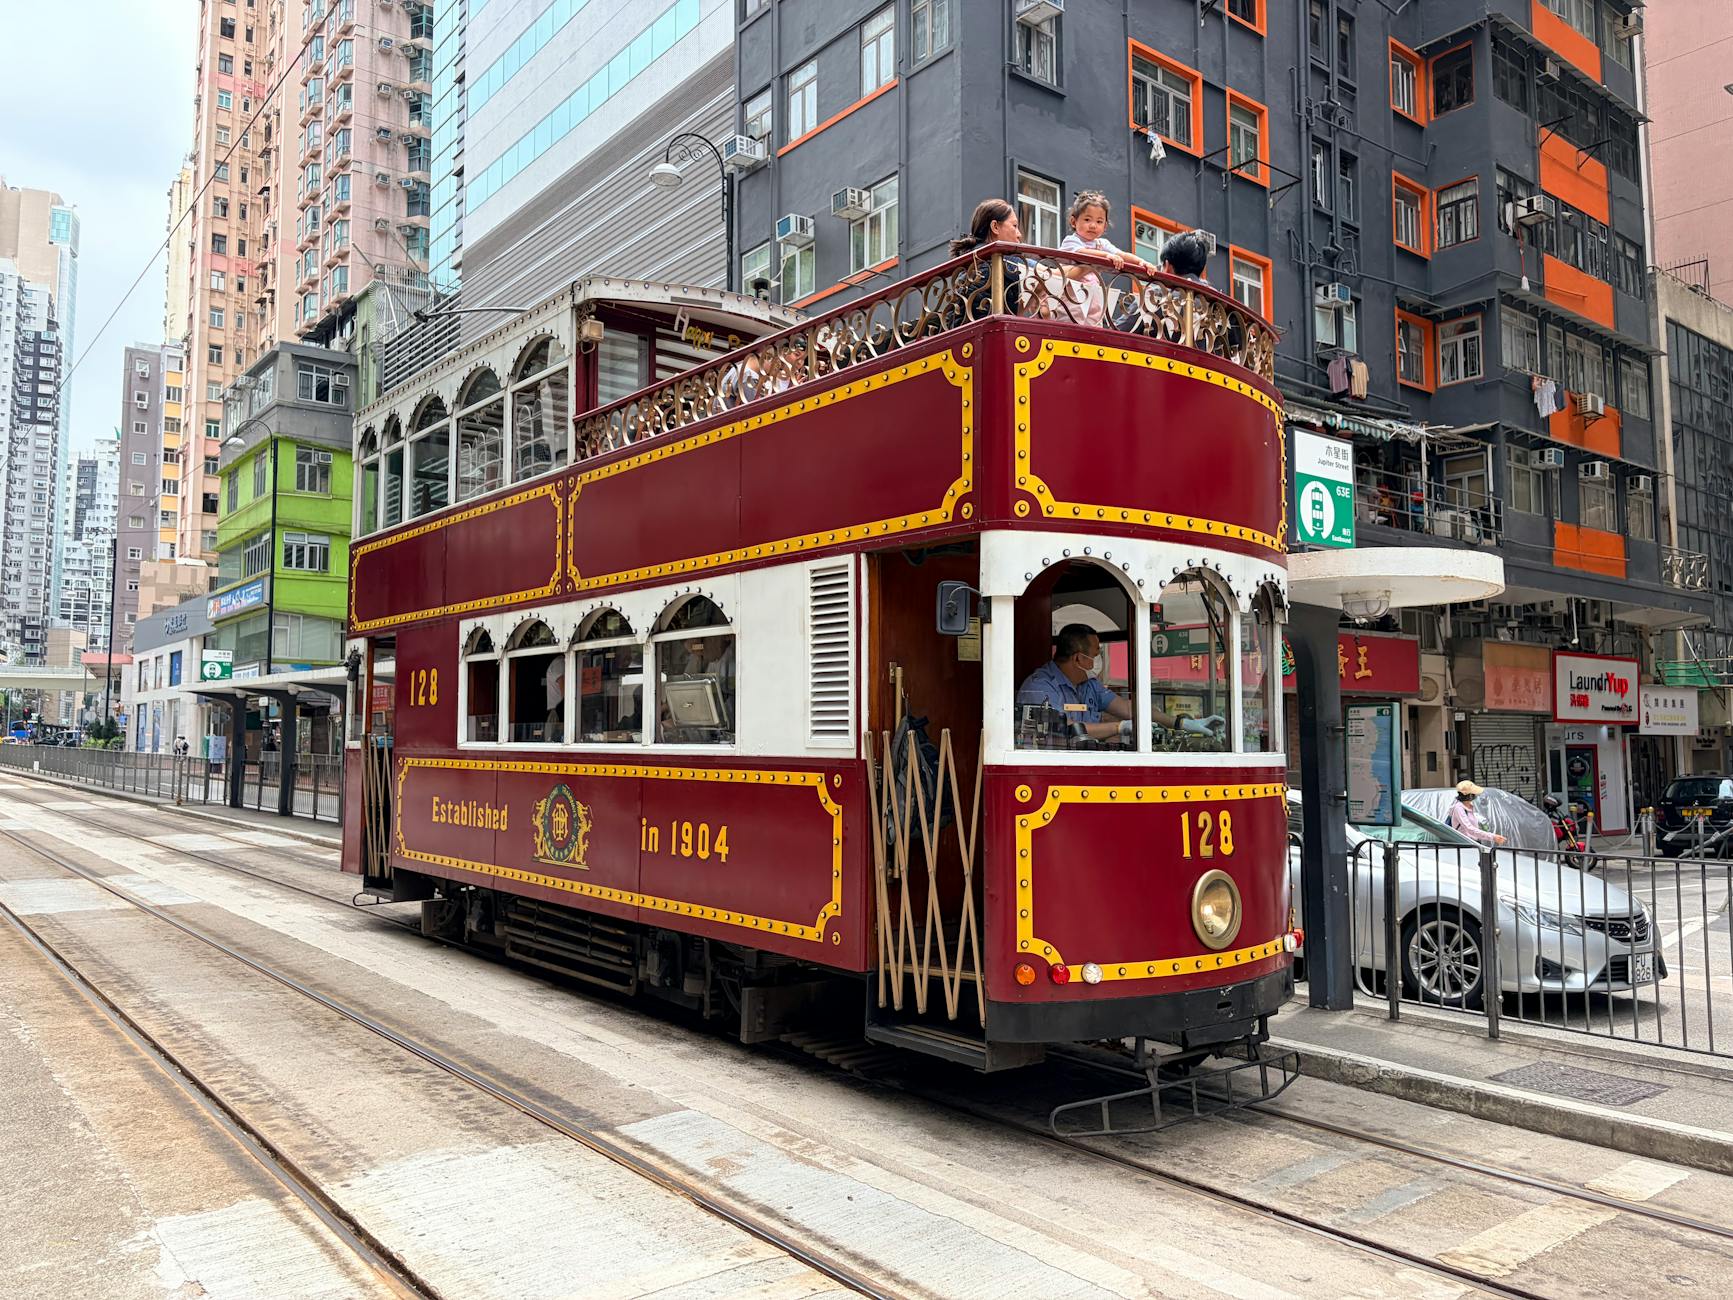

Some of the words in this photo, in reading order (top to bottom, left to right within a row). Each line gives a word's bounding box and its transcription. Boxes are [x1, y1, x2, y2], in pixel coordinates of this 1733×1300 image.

[1317, 457, 1334, 467] Jupiter
[1335, 461, 1349, 471] Street
[1325, 445, 1349, 461] 木星街
[1336, 486, 1350, 498] 63E
[410, 667, 438, 706] 128
[1569, 670, 1629, 699] LaundrYup
[432, 796, 508, 832] Established
[641, 817, 659, 853] in
[671, 820, 729, 863] 1904
[1180, 810, 1234, 859] 128
